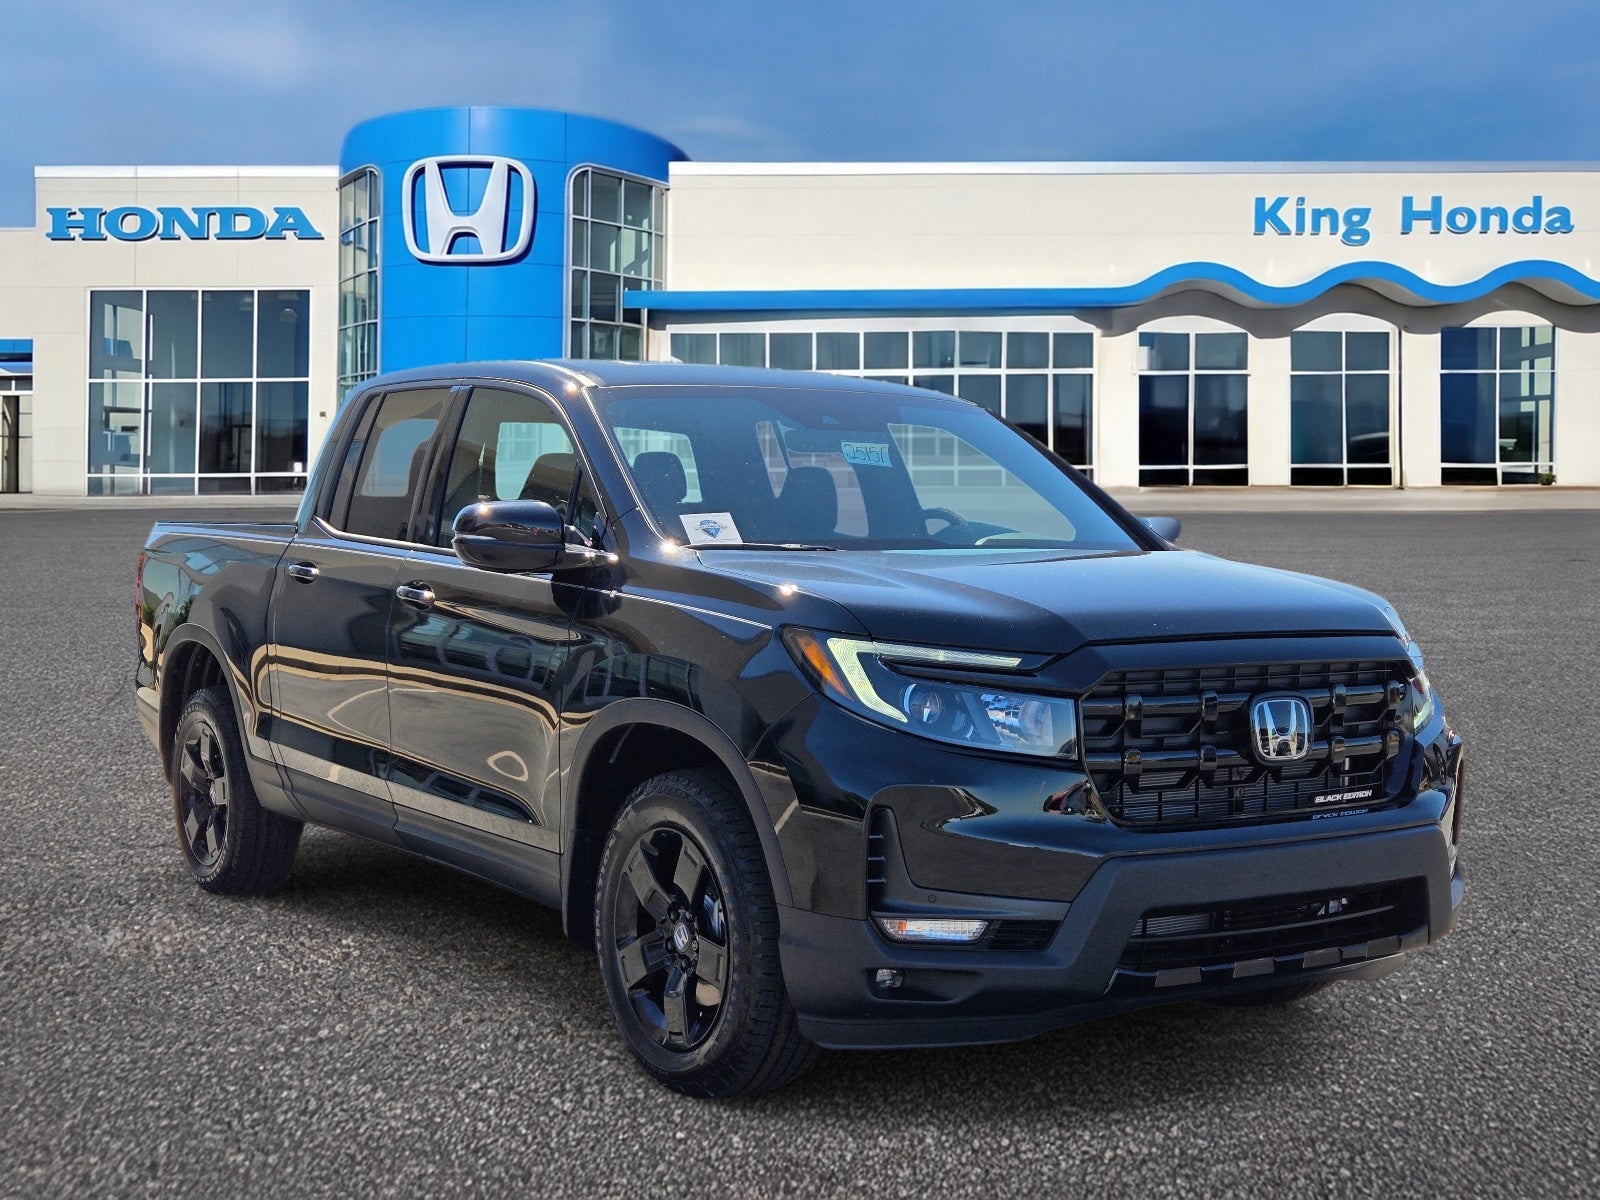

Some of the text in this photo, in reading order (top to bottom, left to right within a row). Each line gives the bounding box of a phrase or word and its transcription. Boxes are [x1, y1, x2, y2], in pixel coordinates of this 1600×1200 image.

[45, 206, 324, 241] HONDA
[1254, 195, 1574, 246] King Honda
[1315, 790, 1372, 803] BLACK EDITION
